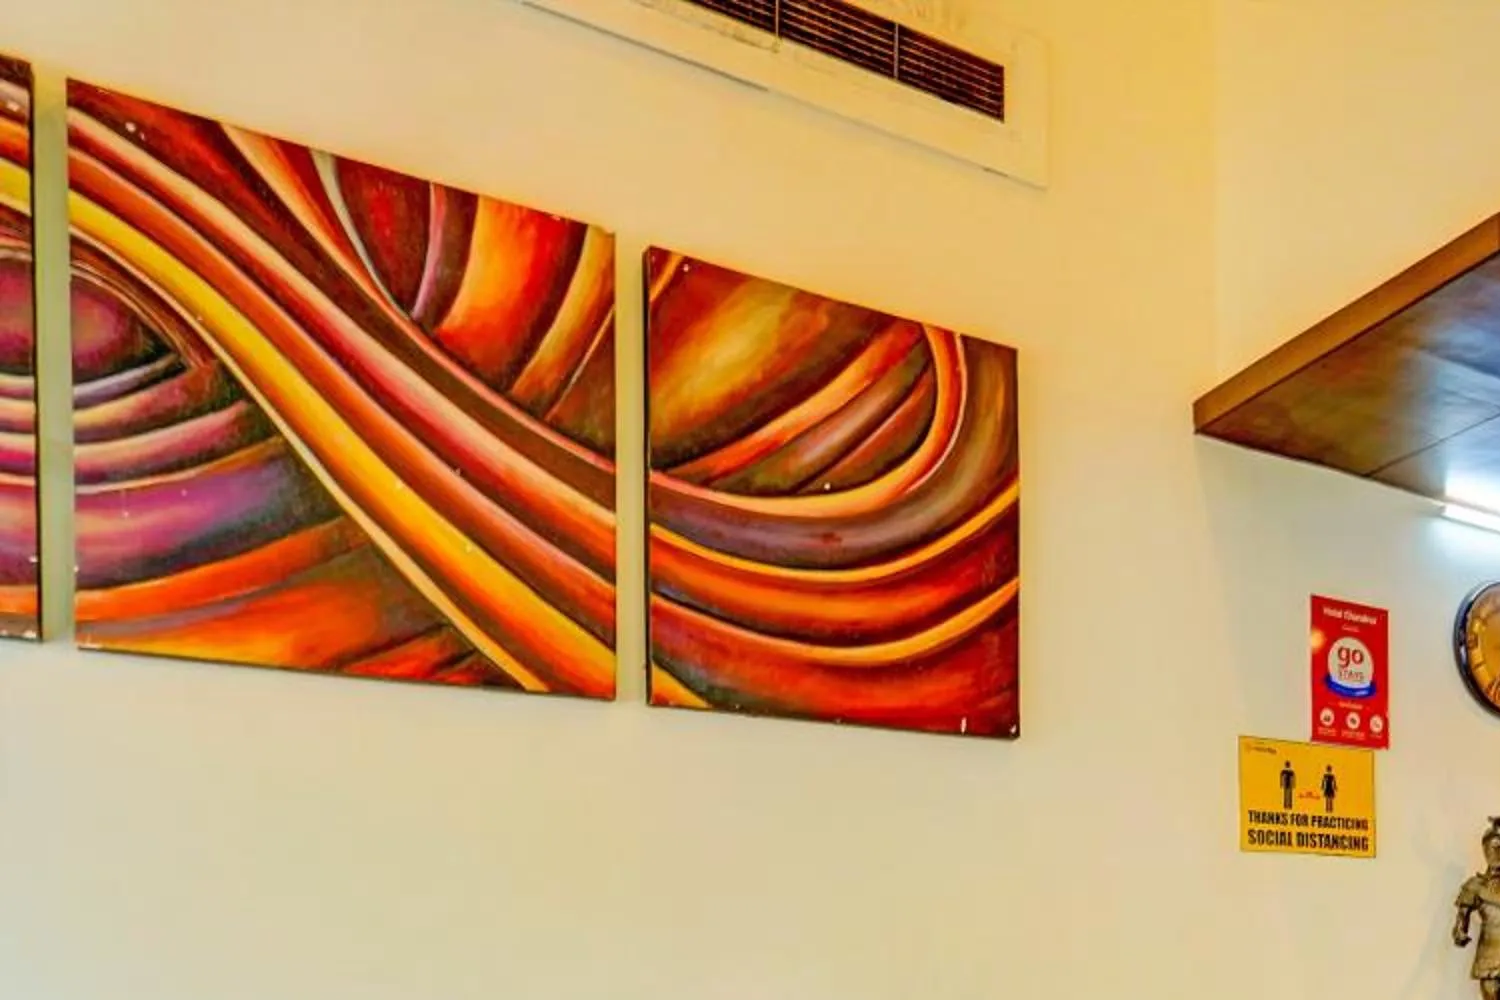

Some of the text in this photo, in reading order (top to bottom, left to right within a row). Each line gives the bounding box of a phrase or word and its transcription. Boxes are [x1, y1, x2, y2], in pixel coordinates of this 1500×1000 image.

[1338, 647, 1364, 668] go
[1248, 810, 1369, 831] THANKS FOR PRACTICING
[1247, 829, 1369, 852] SOCIAL DISTANCING
